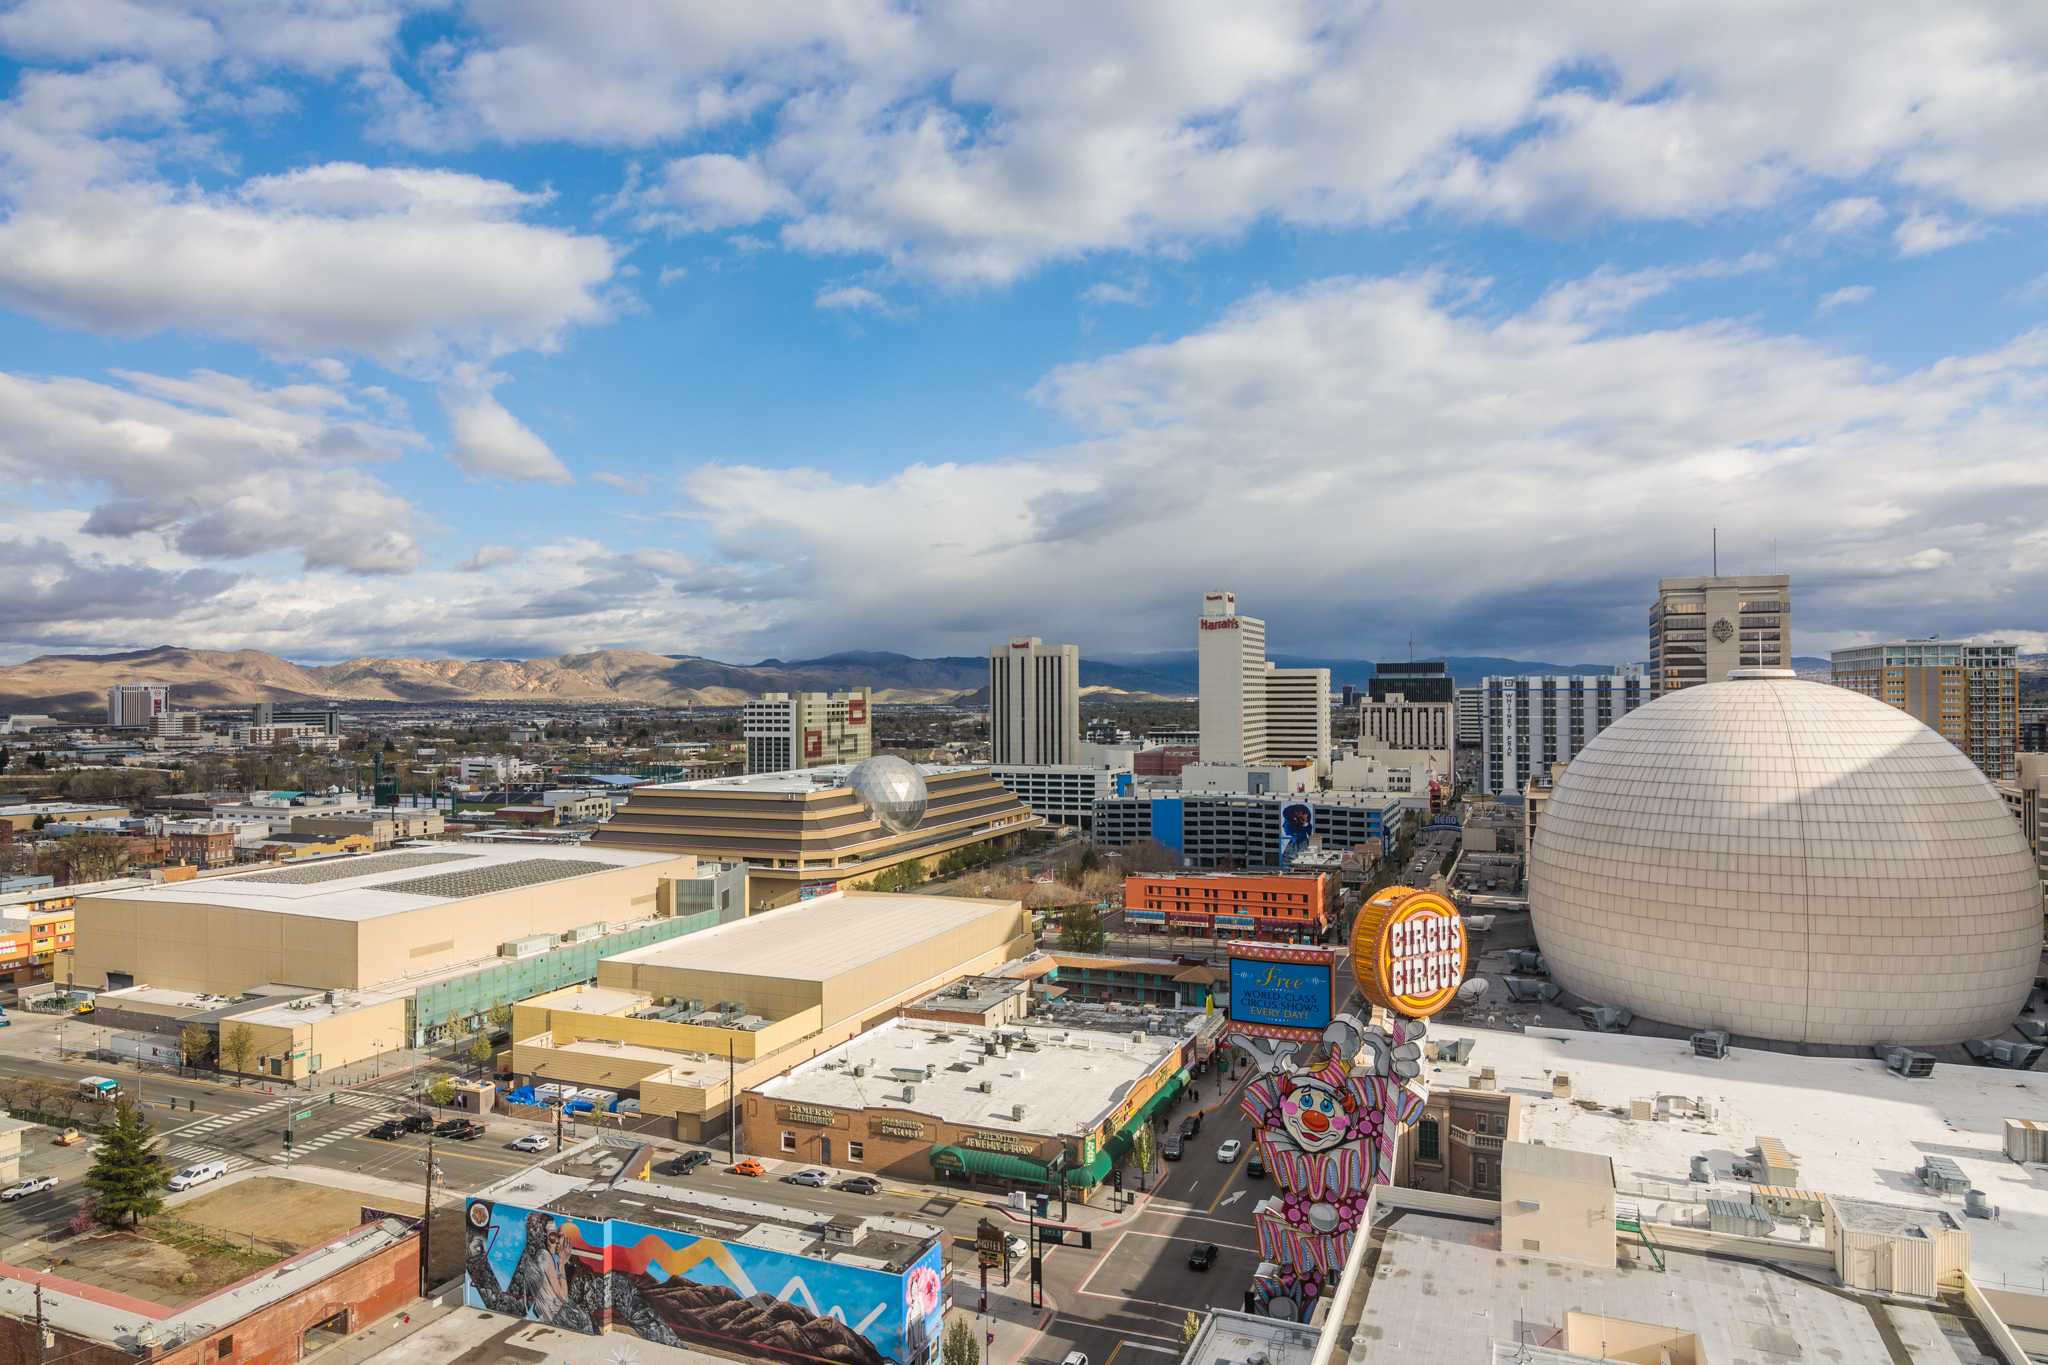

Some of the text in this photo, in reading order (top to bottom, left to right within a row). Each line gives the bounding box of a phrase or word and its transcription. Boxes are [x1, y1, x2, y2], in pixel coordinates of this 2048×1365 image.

[1201, 618, 1239, 630] Harrah's
[1505, 693, 1513, 729] WHITNEY
[1392, 914, 1461, 957] CIRCUS
[1256, 966, 1303, 989] Free
[1392, 952, 1462, 996] CIRCUS
[1243, 990, 1317, 1003] WORLD-CLASS
[1240, 998, 1320, 1013] CIRCUS SHOWS
[1250, 1007, 1308, 1020] EVERY DAY!
[789, 1105, 834, 1117] CAMERAS
[882, 1117, 923, 1130] DIAMONDS
[894, 1126, 923, 1138] GOLD
[978, 1131, 1019, 1144] PREMIER
[966, 1138, 1001, 1151] JEWELRY
[1011, 1144, 1032, 1154] LOAN
[977, 1239, 1001, 1251] MOTEL
